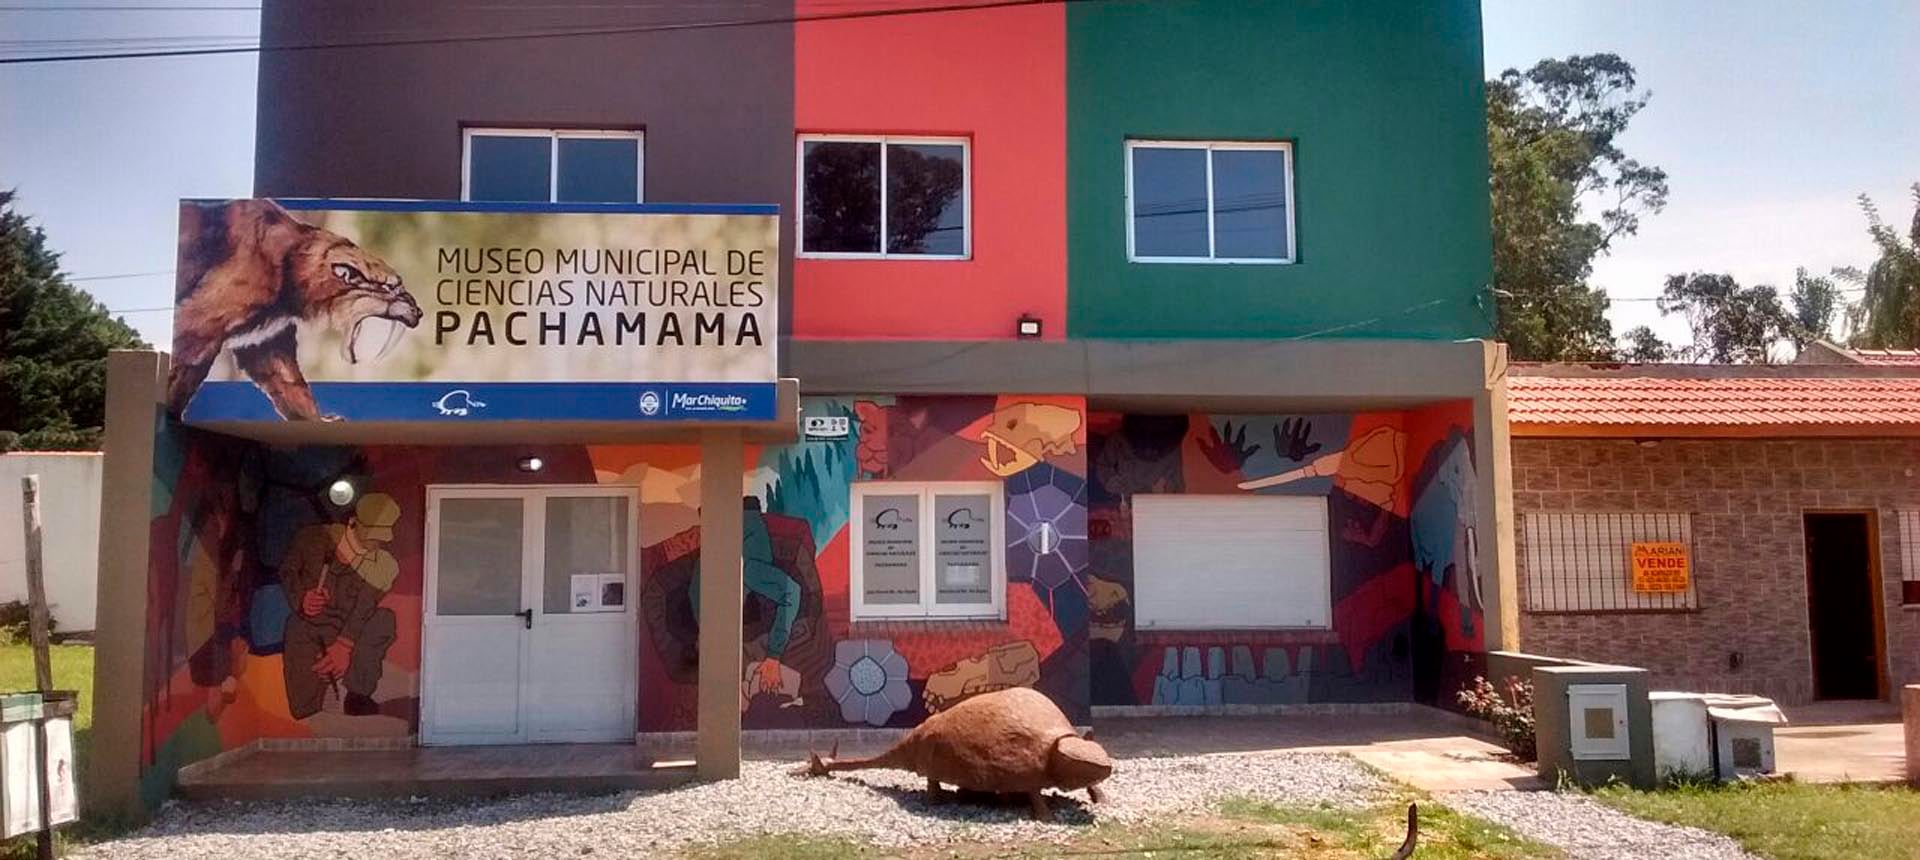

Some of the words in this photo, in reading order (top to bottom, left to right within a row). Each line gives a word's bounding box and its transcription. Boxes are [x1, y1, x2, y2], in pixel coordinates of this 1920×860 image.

[437, 248, 544, 275] MUSEO
[556, 249, 716, 276] MUNICIPAL
[727, 250, 764, 276] DE
[436, 279, 574, 306] CIENCIAS
[586, 280, 763, 307] NATURALES
[435, 311, 763, 346] PACHAMAMA
[1636, 558, 1685, 568] VENDE
